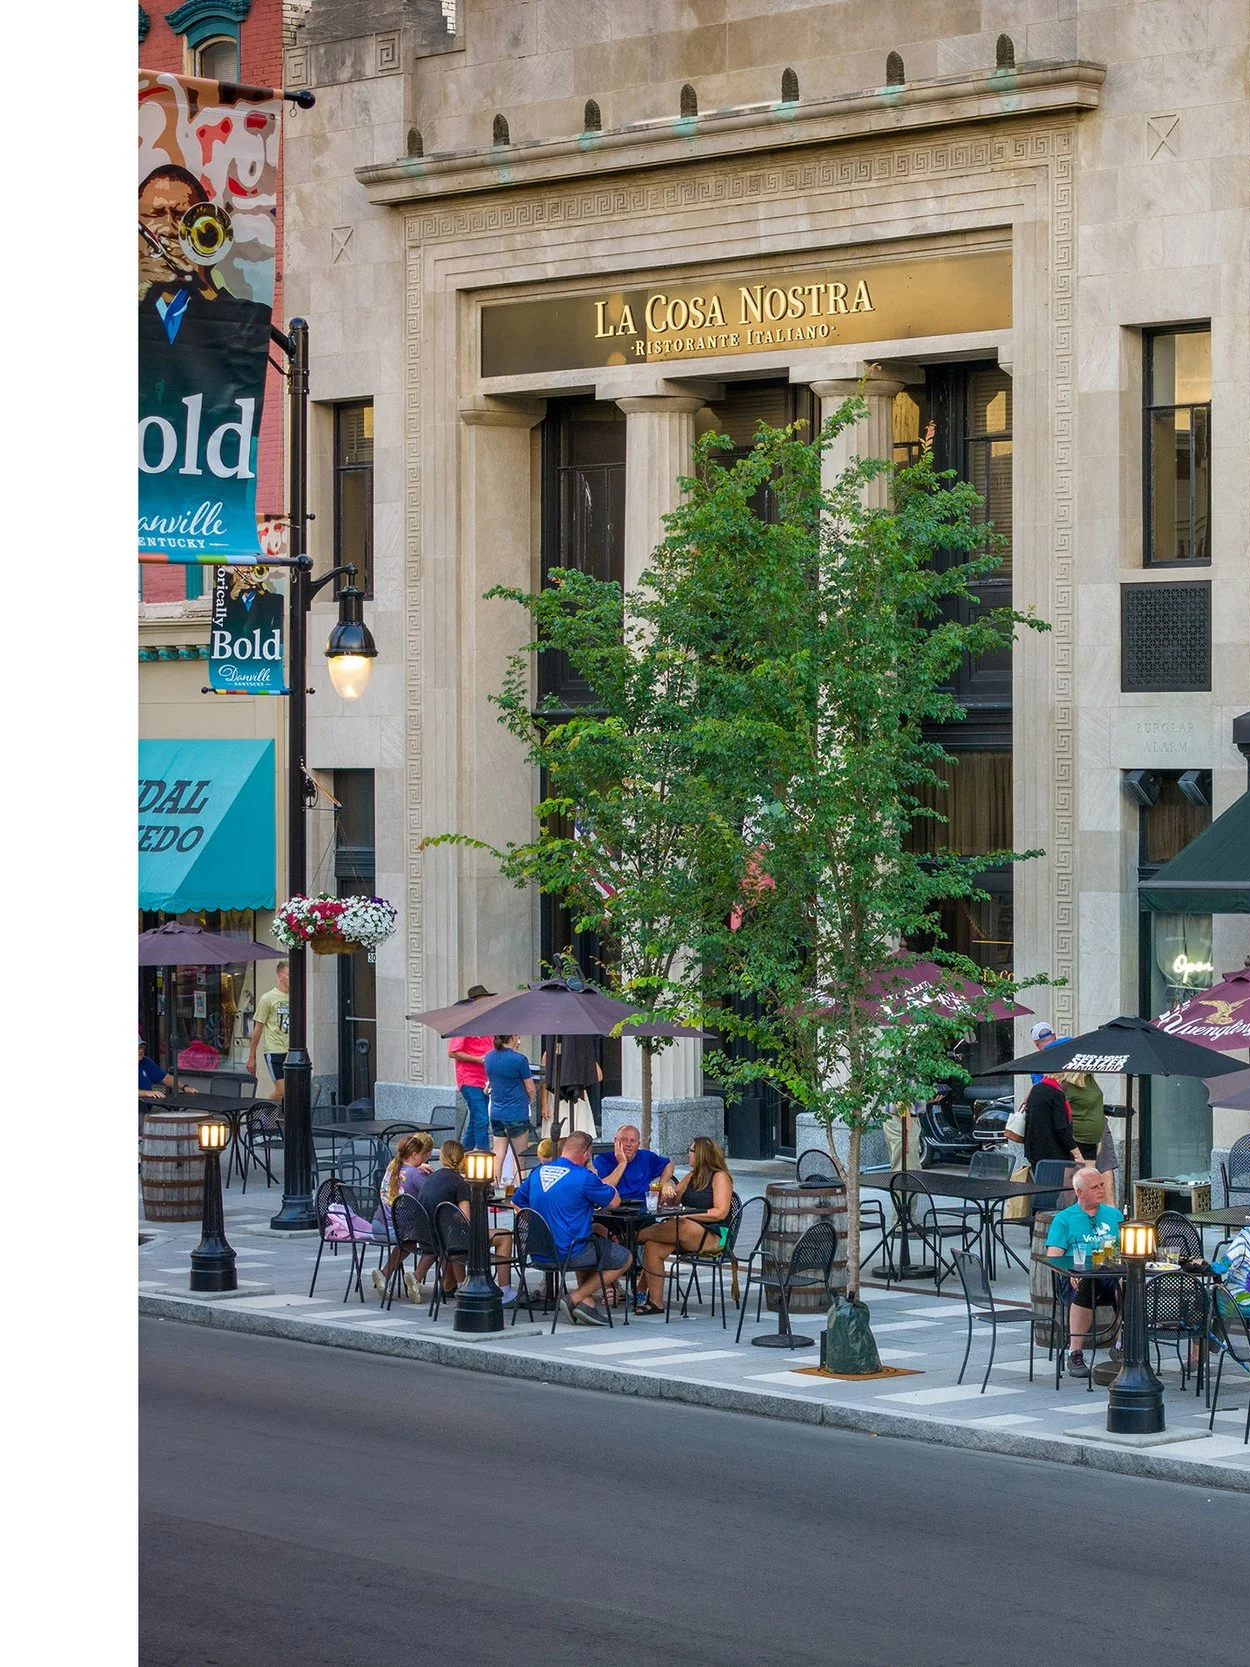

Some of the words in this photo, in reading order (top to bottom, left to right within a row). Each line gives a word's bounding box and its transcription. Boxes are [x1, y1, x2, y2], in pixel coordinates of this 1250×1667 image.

[594, 301, 639, 338] LA
[645, 294, 728, 333] COSA
[738, 280, 876, 325] NOSTRA
[635, 333, 740, 356] RISTORANTE
[747, 323, 830, 346] ITALIANO
[213, 565, 228, 628] orically
[211, 628, 282, 660] Bold
[218, 664, 272, 682] Danville
[1136, 722, 1194, 734] BURGLAR
[1143, 741, 1187, 753] ALARM
[138, 780, 211, 813] DAL
[138, 825, 204, 853] EDO
[1173, 954, 1213, 983] Open
[1071, 1058, 1127, 1068] SELTZER
